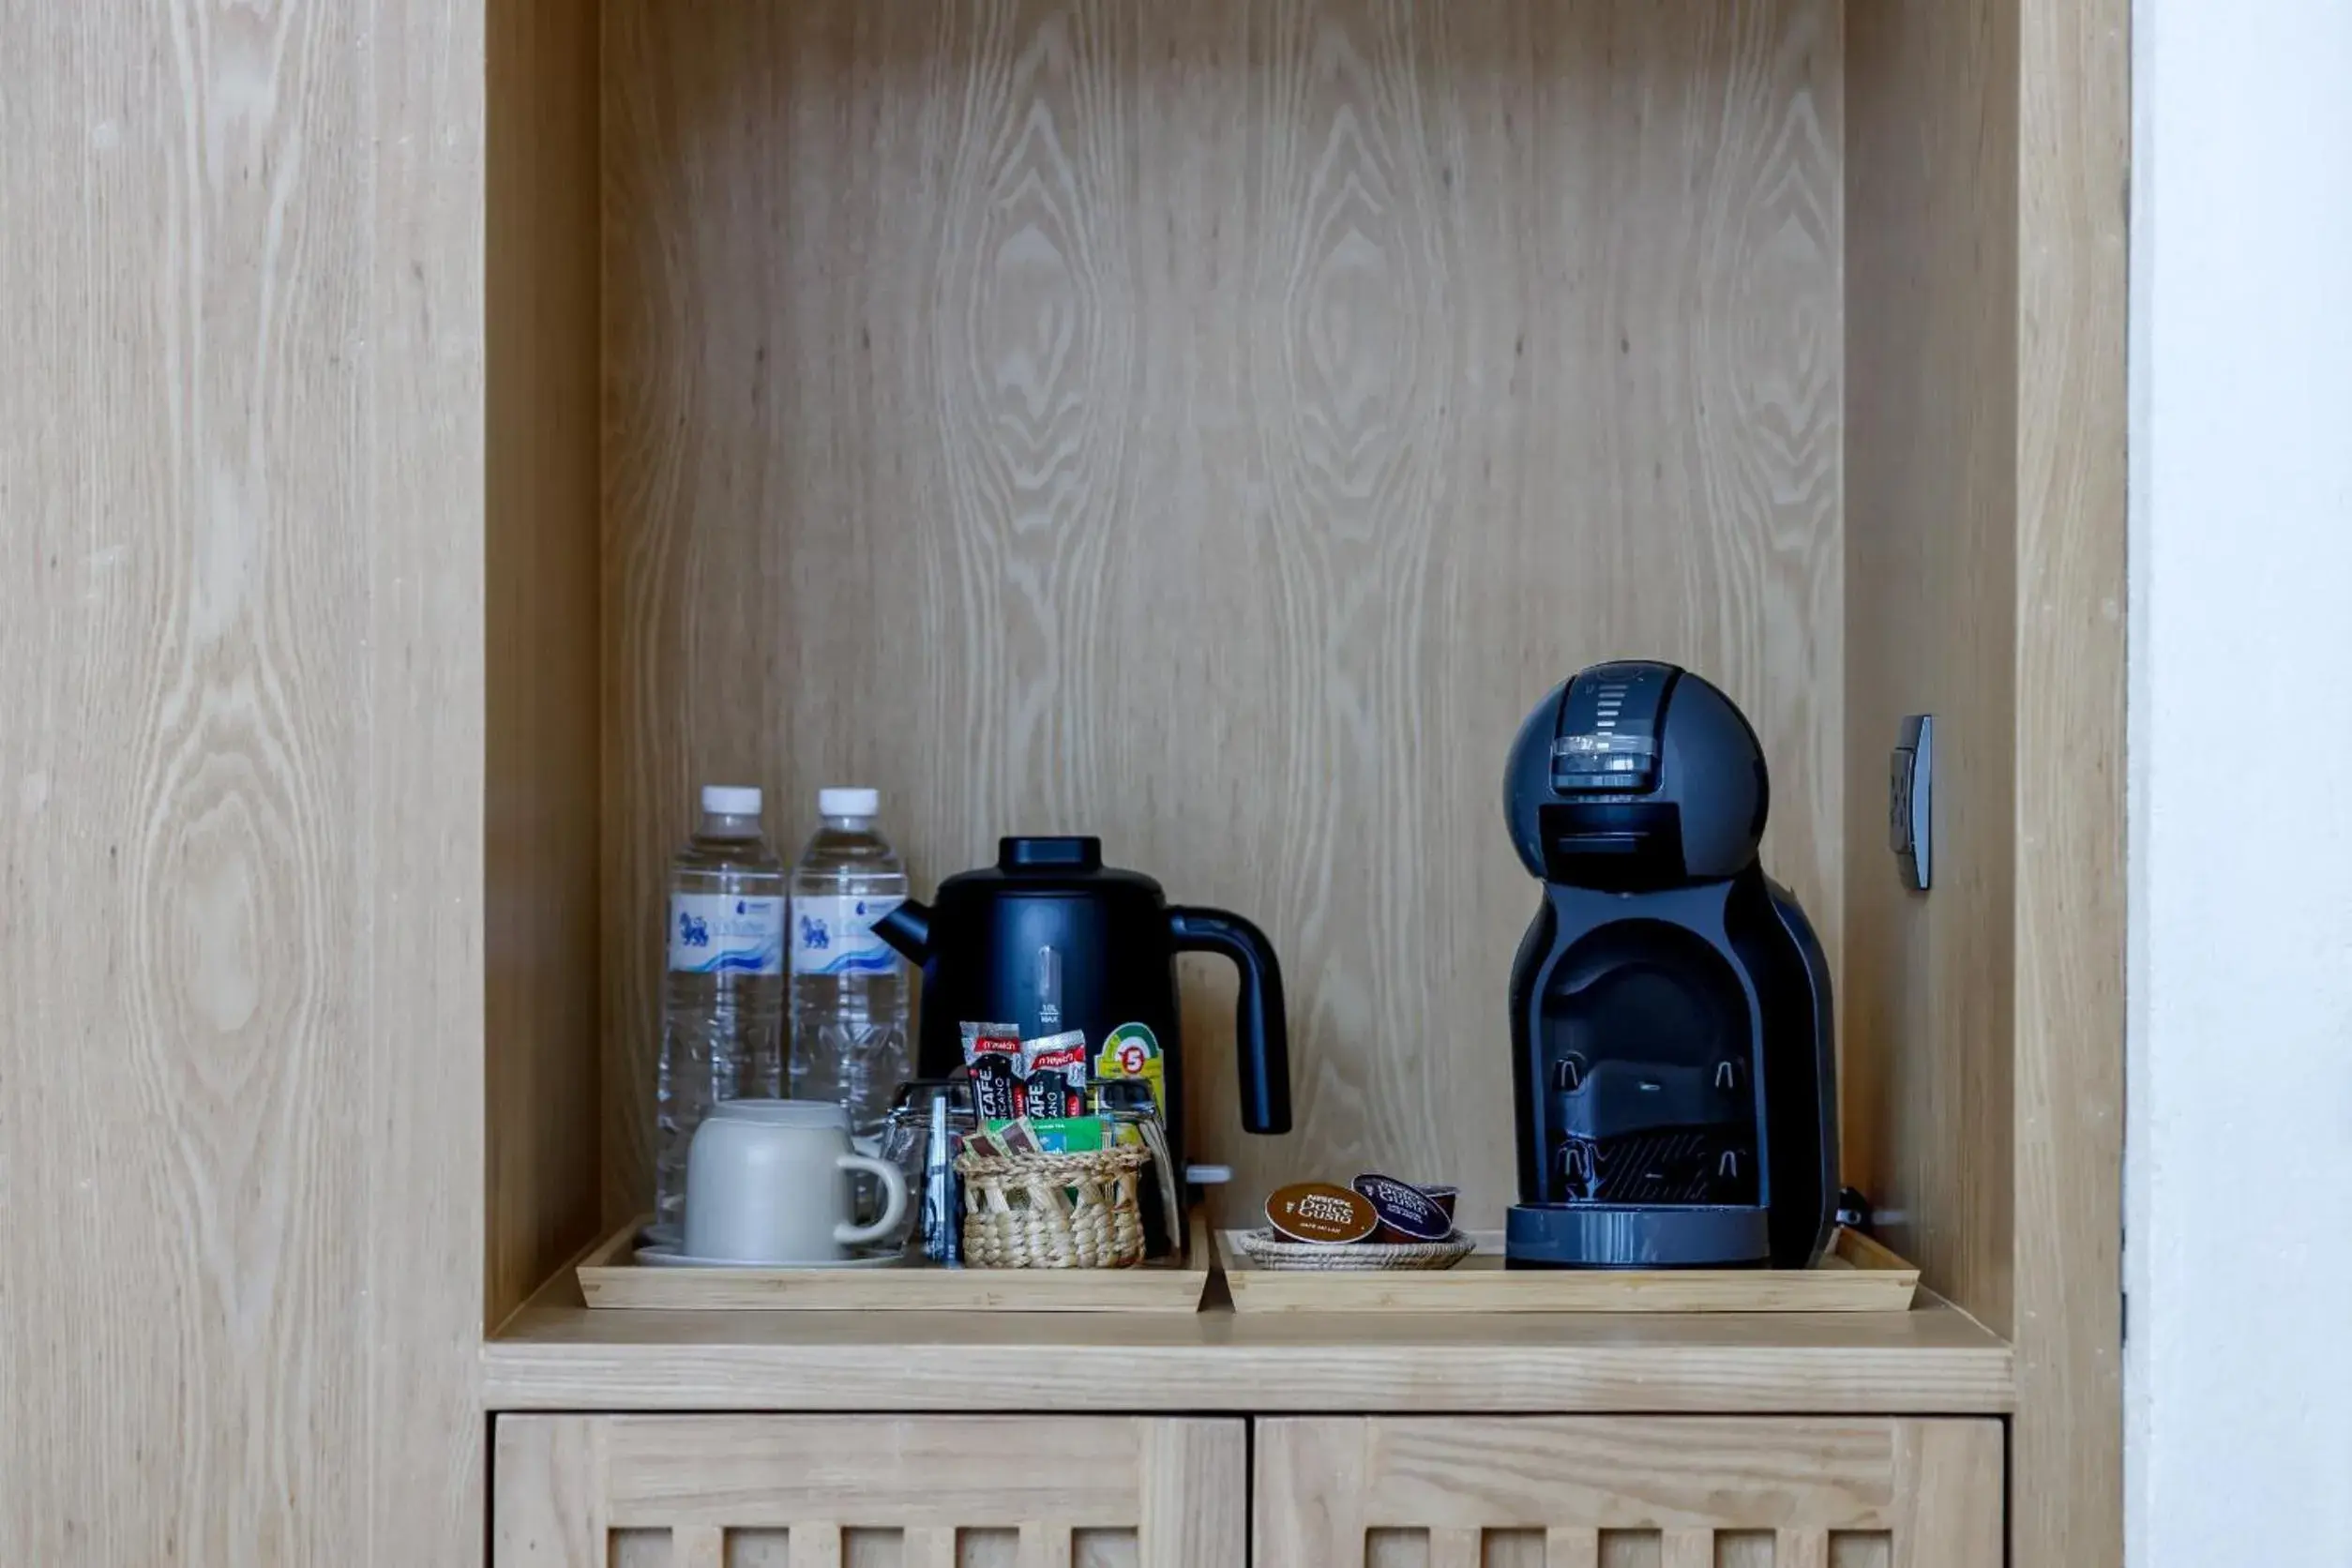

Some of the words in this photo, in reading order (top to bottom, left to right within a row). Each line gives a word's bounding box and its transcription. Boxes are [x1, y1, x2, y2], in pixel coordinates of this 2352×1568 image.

[1040, 1015, 1059, 1024] MAX
[1127, 1048, 1143, 1073] 5
[1301, 1199, 1354, 1215] Dolce
[1298, 1208, 1352, 1224] Gusto
